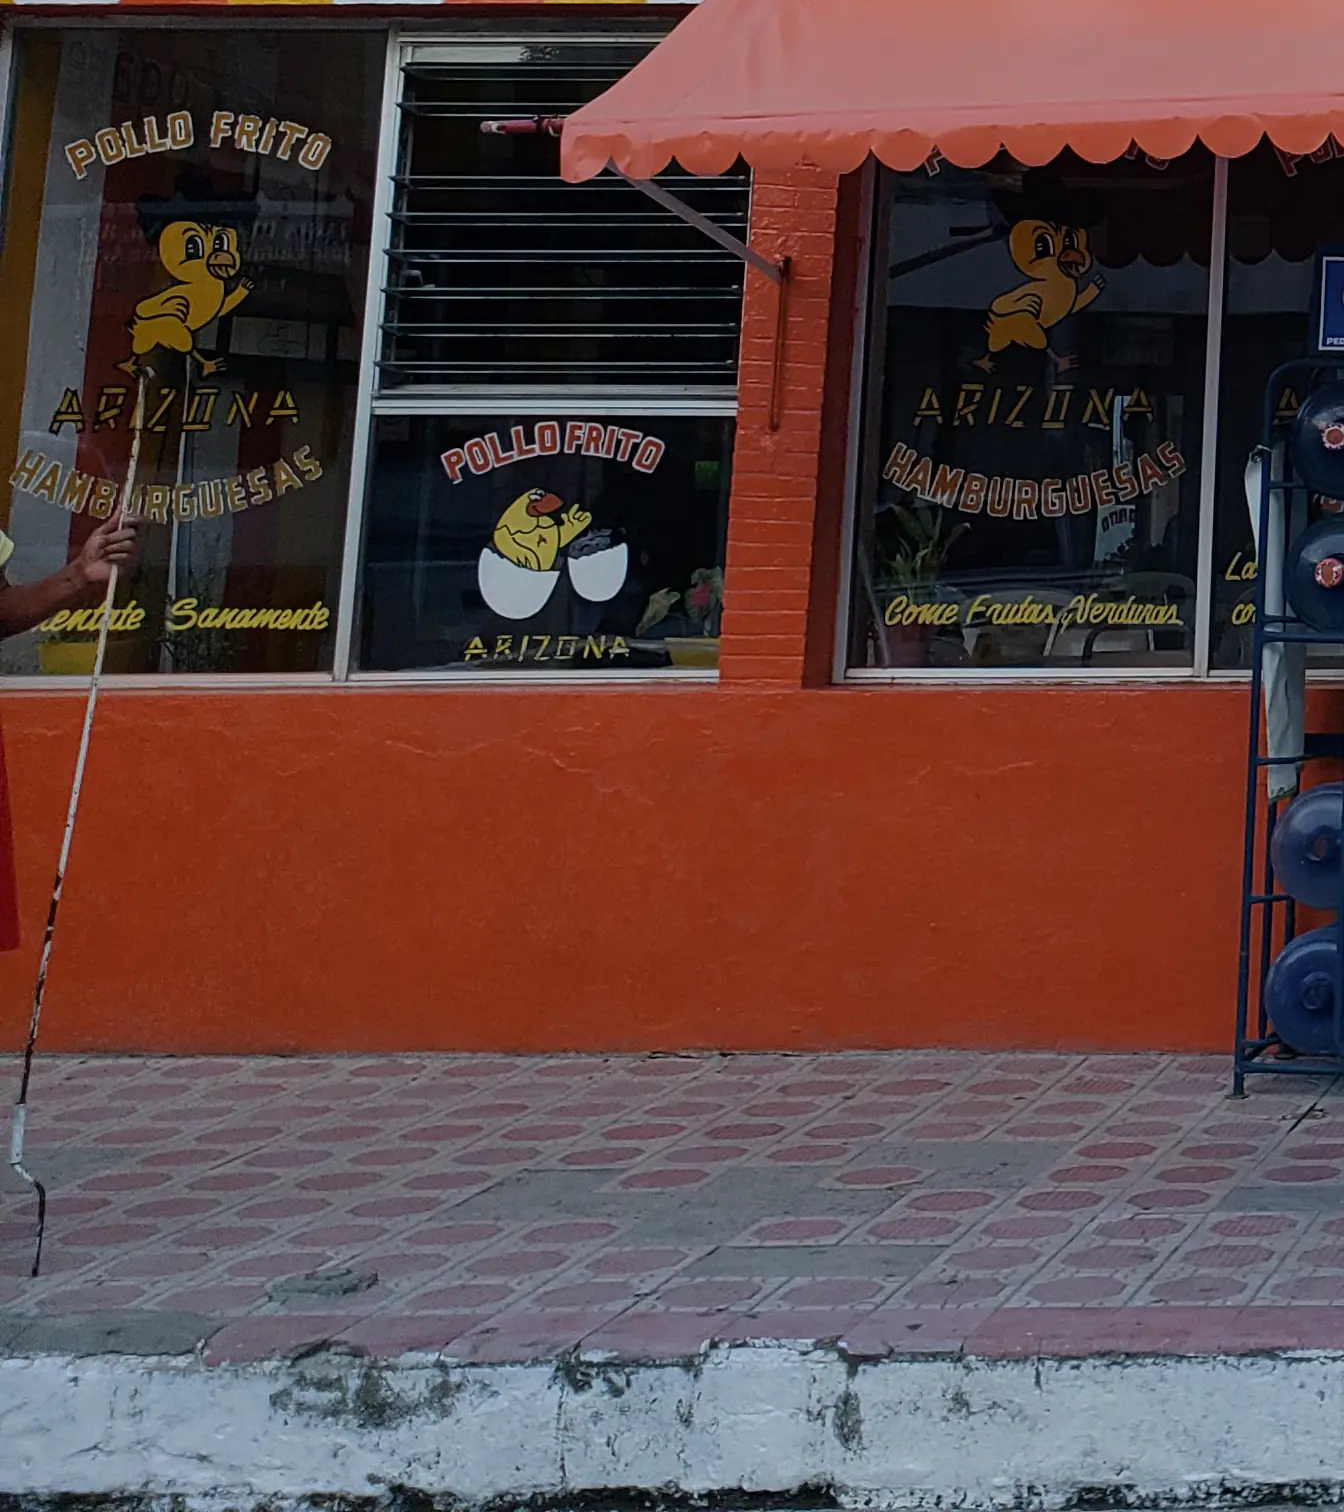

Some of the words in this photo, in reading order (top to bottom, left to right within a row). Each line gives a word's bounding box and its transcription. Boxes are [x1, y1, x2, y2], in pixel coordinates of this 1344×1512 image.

[65, 110, 195, 179] POLLO
[210, 110, 332, 171] FRITO
[48, 386, 303, 436] ARIZONA
[912, 383, 1156, 431] ARIZONA
[441, 421, 558, 483] POLLO
[563, 421, 665, 474] FRITO
[882, 439, 1188, 521] HAMBURGUESAS
[166, 598, 330, 632] Sanamente
[884, 595, 958, 627] Come
[965, 594, 1056, 627] Frutas
[1068, 593, 1185, 627] Verduras
[463, 634, 631, 662] ARIZONA
